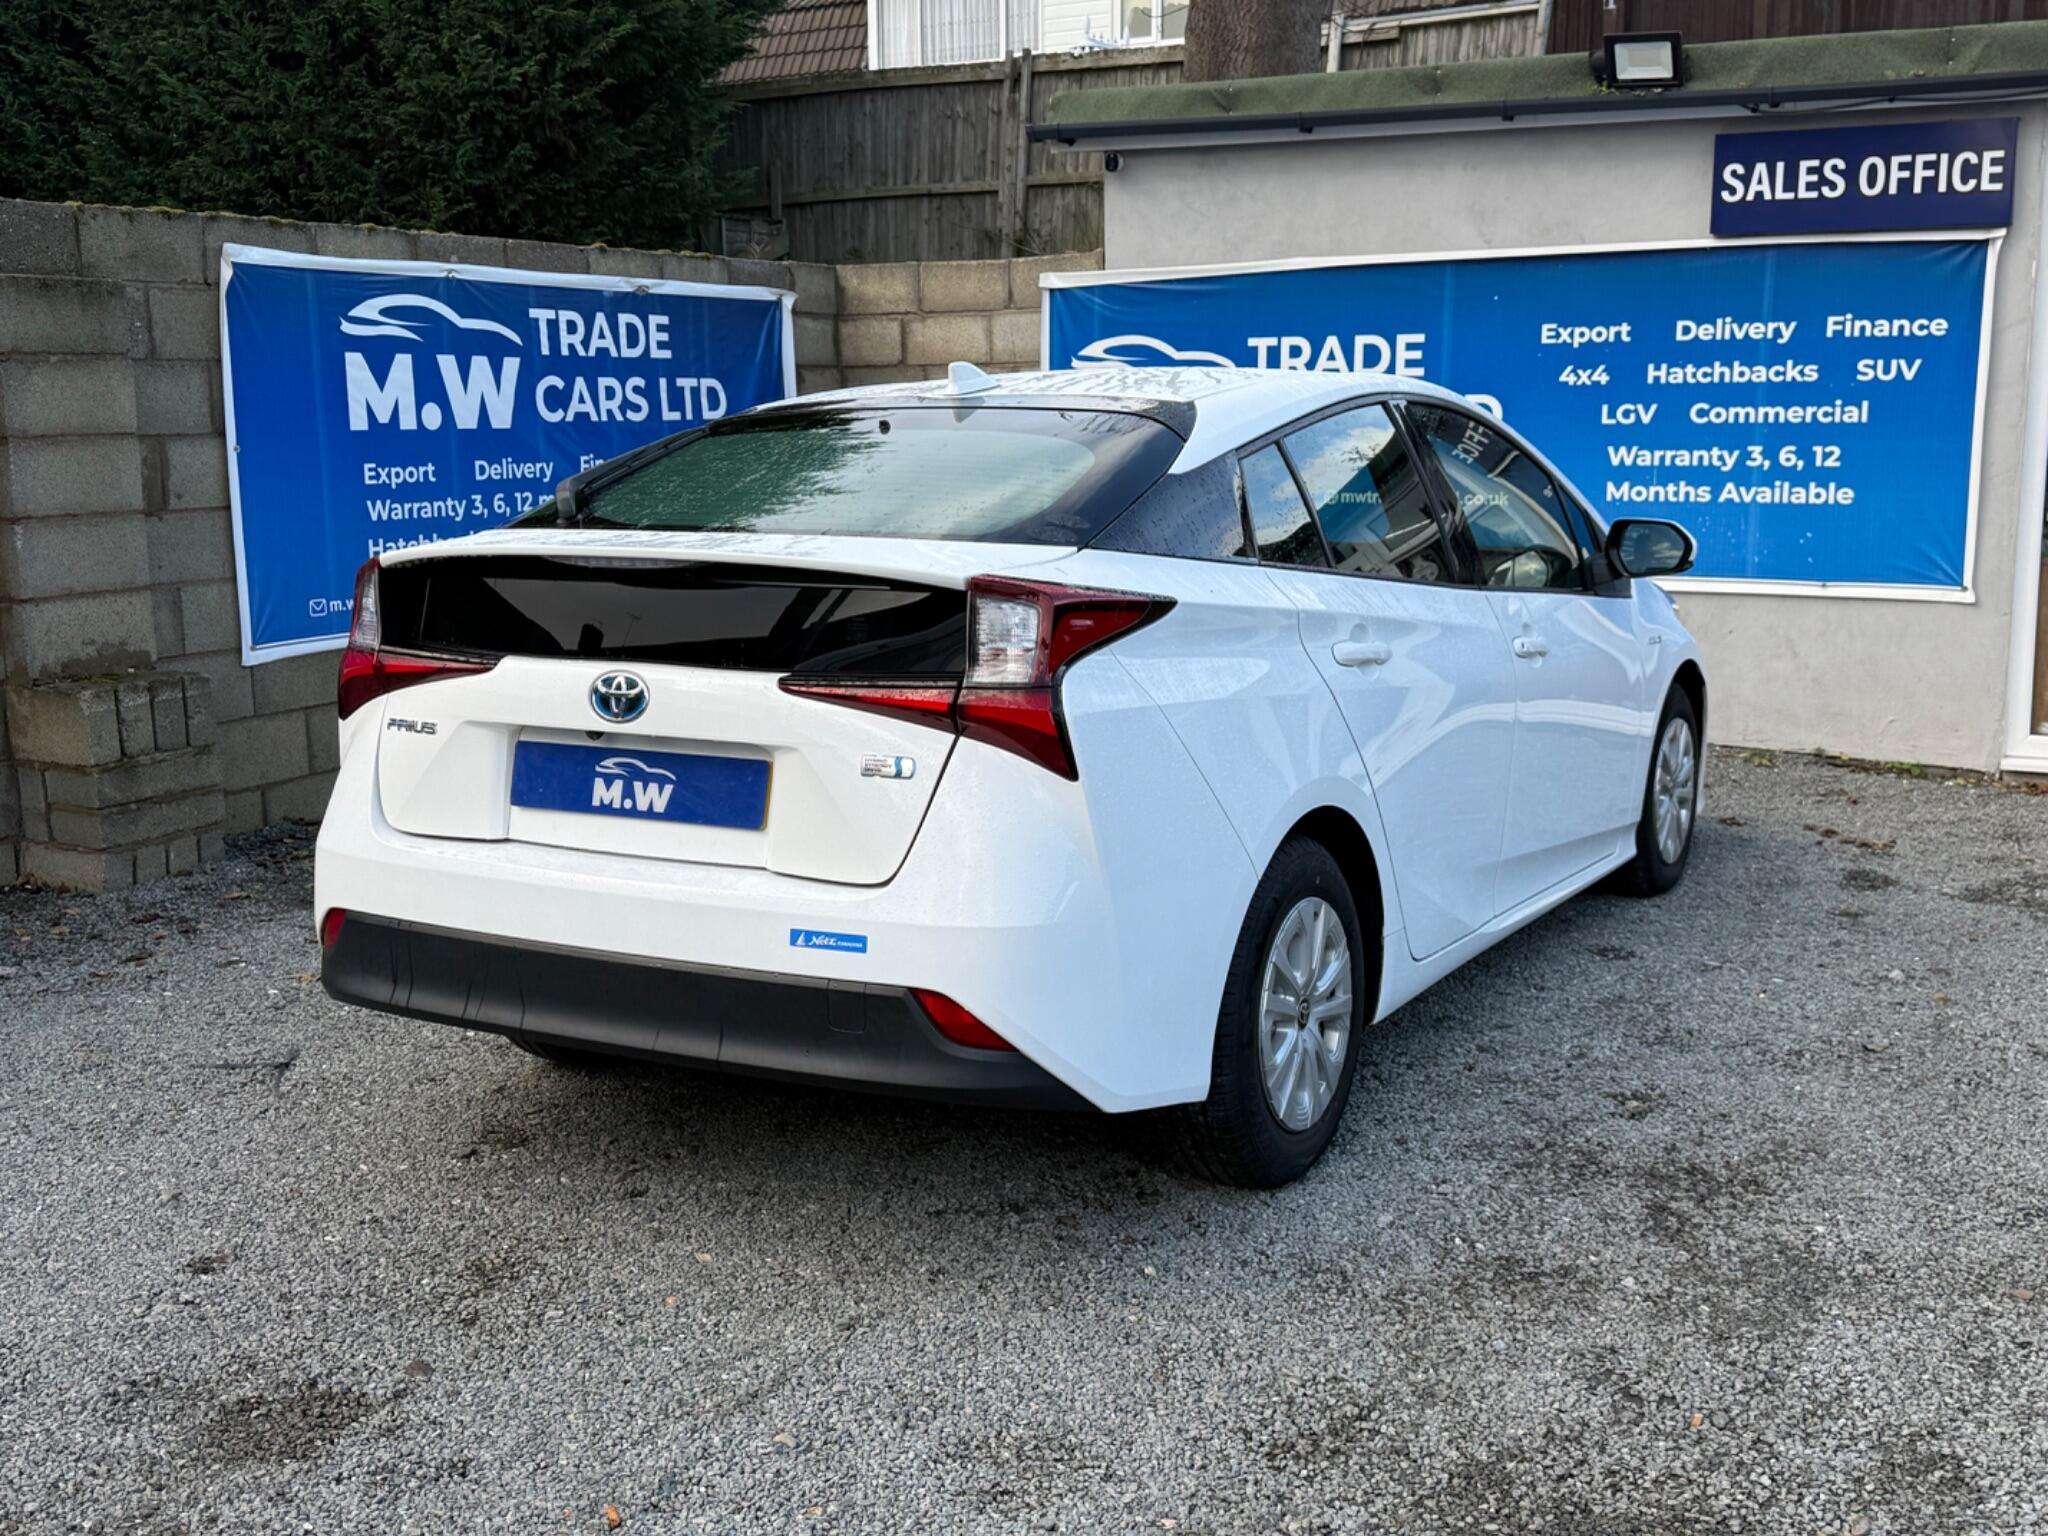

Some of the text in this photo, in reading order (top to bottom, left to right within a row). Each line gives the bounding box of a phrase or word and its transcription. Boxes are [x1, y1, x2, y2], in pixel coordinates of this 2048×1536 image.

[1721, 150, 2005, 202] SALES OFFICE
[529, 308, 671, 358] TRADE
[1542, 314, 1948, 347] Export Delivery Finance
[1247, 334, 1425, 377] TRADE
[1559, 359, 1921, 385] 4x4 Hatchbacks SUV
[345, 352, 520, 430] M.W
[536, 376, 727, 422] CARS LTD
[1602, 400, 1868, 424] LGV Commercial
[364, 463, 436, 488] Export
[475, 458, 553, 482] Delivery
[1608, 446, 1840, 471] Warranty 3, 6, 12
[367, 498, 466, 521] Warranty
[472, 495, 488, 518] 3,
[494, 493, 509, 516] 6,
[515, 492, 533, 513] 12
[1607, 481, 1854, 504] Months Available
[591, 777, 674, 814] M.W
